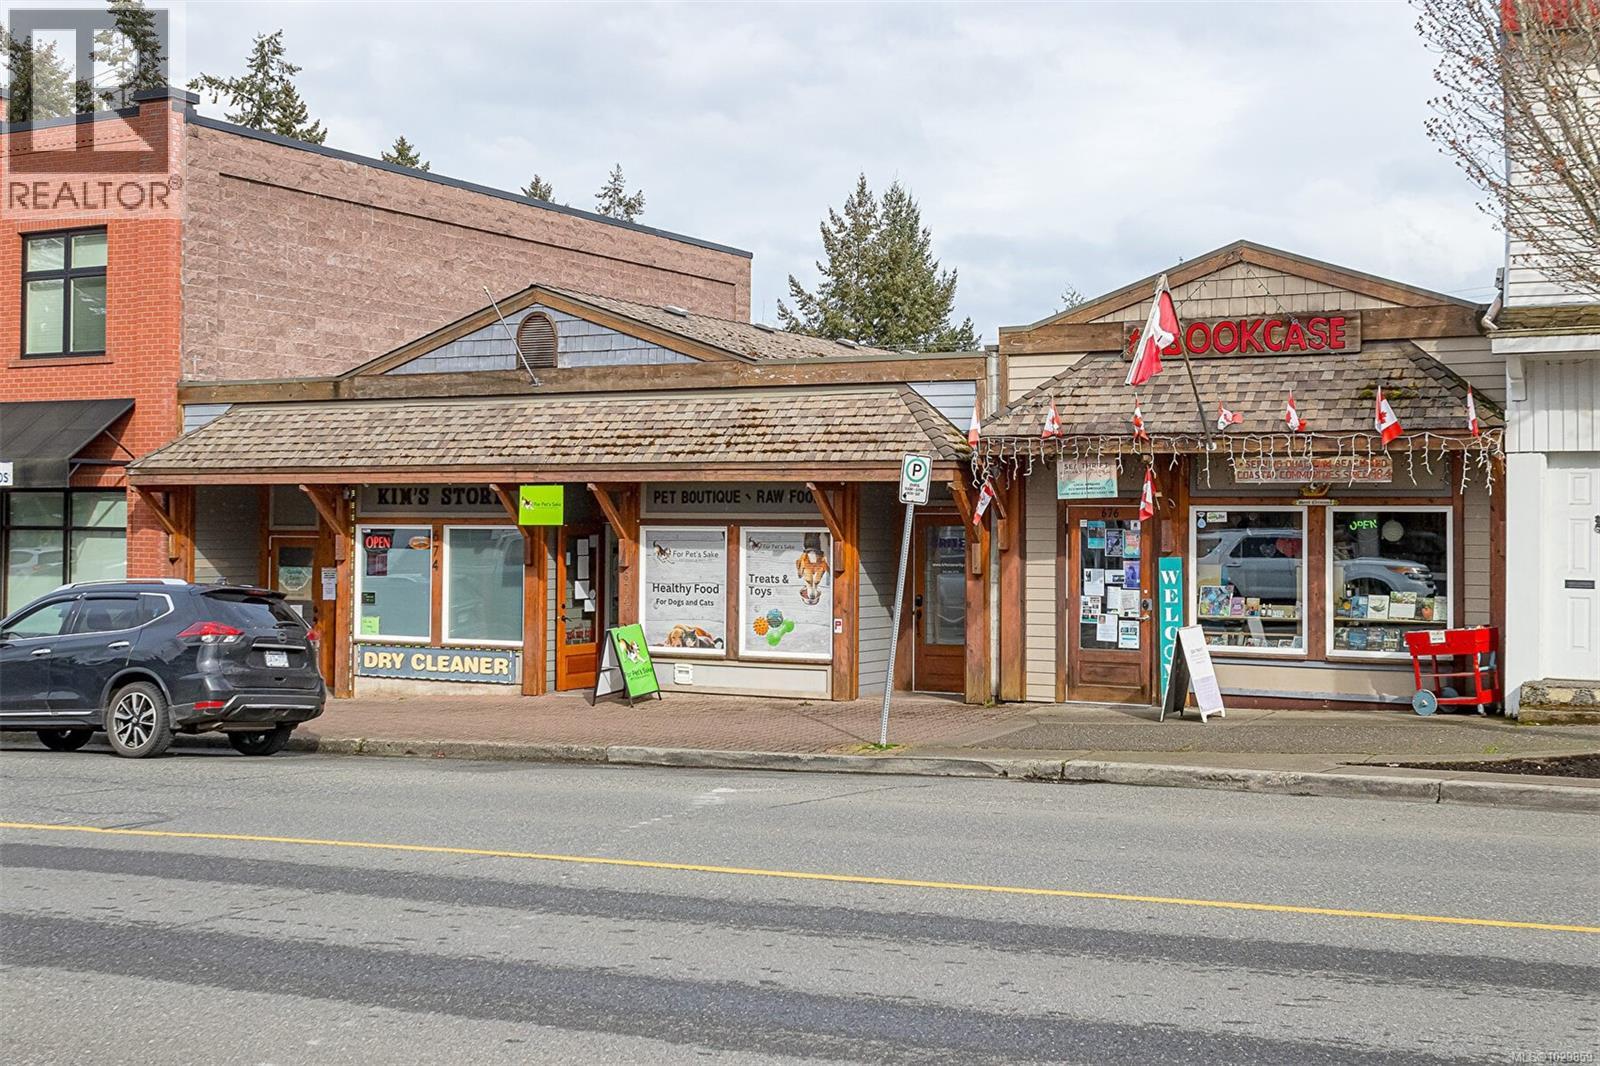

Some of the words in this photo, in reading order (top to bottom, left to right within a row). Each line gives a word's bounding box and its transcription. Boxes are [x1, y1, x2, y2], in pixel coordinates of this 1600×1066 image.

[912, 463, 922, 477] P
[377, 488, 430, 505] KIM'S
[654, 490, 676, 504] PET
[681, 490, 741, 504] BOUTIQUE
[757, 489, 784, 504] RAW
[789, 490, 816, 504] FOO
[1350, 519, 1378, 531] OPEN
[366, 536, 391, 549] OPEN
[672, 550, 684, 558] For
[685, 550, 702, 558] Pet's
[702, 550, 719, 558] Sake
[749, 573, 780, 584] Treats
[782, 574, 789, 584] &
[652, 583, 692, 596] Healthy
[694, 583, 720, 594] Food
[749, 586, 772, 598] Toys
[668, 599, 684, 607] Dogs
[699, 599, 714, 607] Cats
[363, 651, 405, 670] DRY
[411, 653, 509, 675] CLEANER
